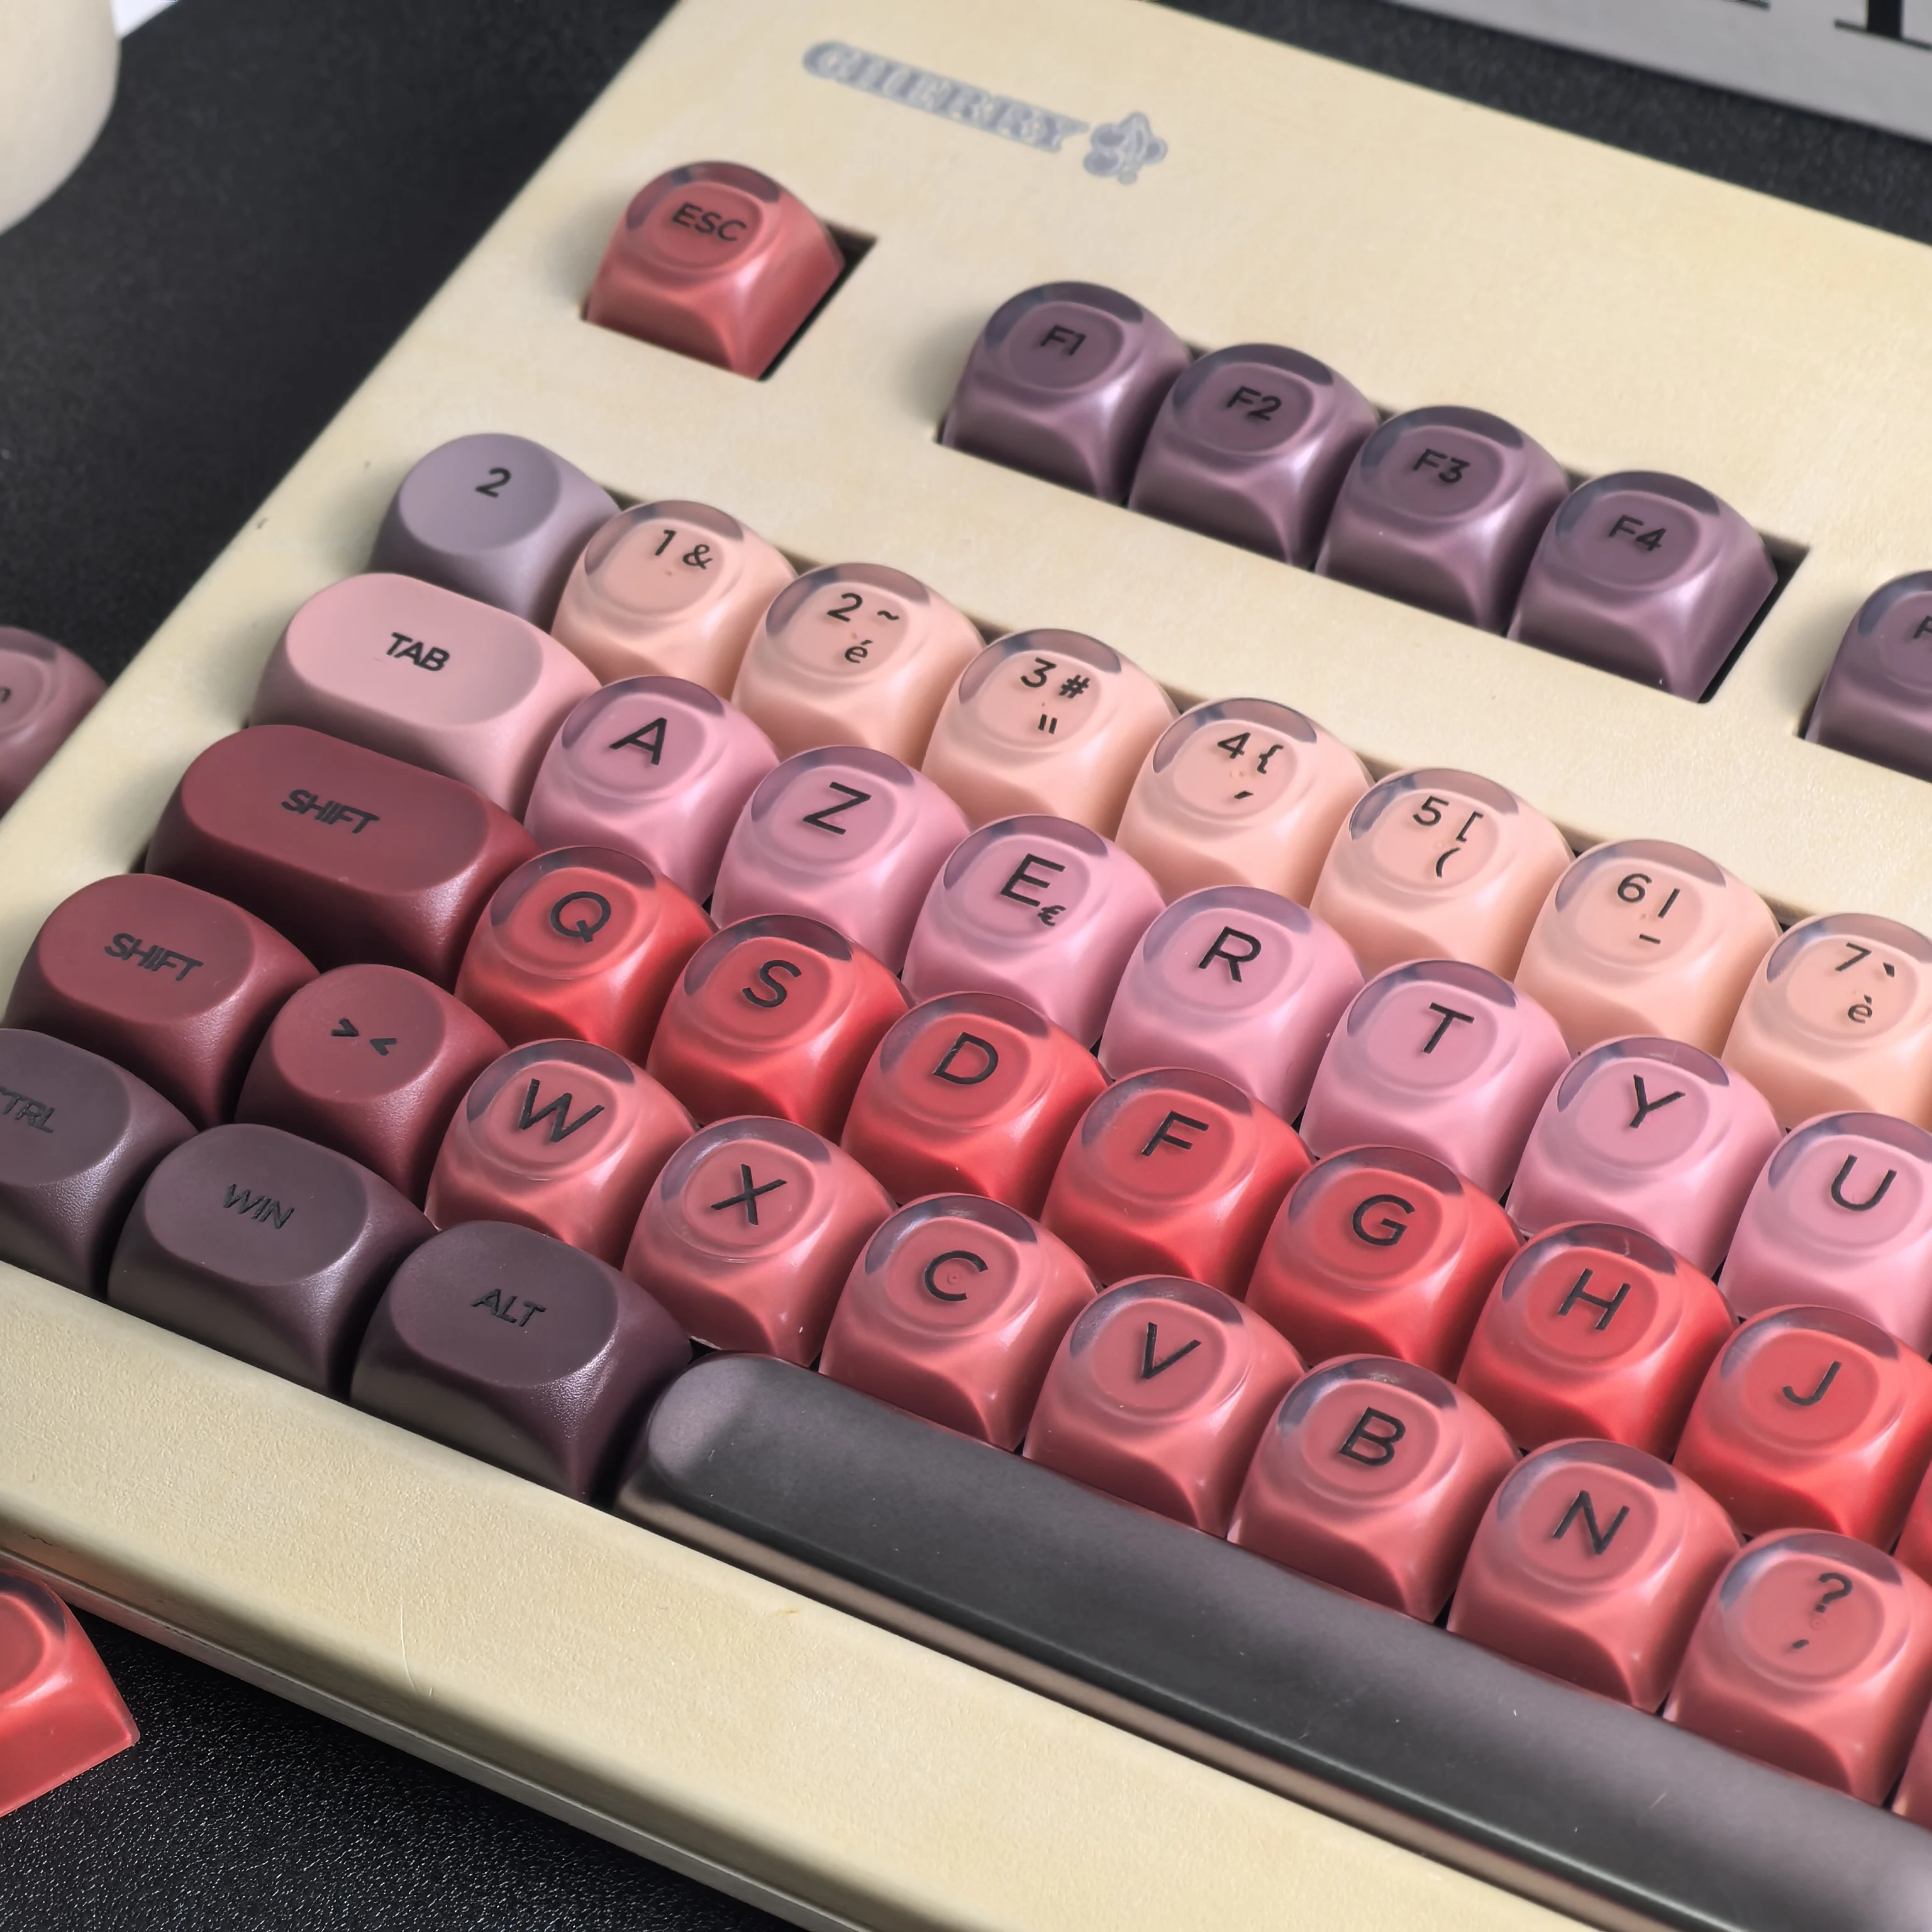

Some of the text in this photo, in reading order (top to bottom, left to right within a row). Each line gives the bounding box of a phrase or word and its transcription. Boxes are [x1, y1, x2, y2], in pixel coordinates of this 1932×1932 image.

[672, 202, 747, 242] ESC
[1040, 325, 1086, 356] F1
[1226, 386, 1282, 421] F2
[475, 467, 511, 498] 2
[1413, 448, 1471, 484] F3
[654, 529, 713, 570] 1 &
[1608, 514, 1667, 552] F4
[826, 592, 863, 623] 2
[385, 631, 451, 672] TAB
[844, 639, 874, 663] é
[1020, 657, 1057, 688] 3
[609, 717, 667, 765] A
[281, 789, 380, 835] SHIFT
[802, 781, 872, 835] Z
[1000, 853, 1065, 908] E
[550, 891, 612, 943] Q
[104, 933, 204, 981] SHIFT
[1197, 926, 1262, 983] R
[741, 959, 802, 1008] S
[1423, 1002, 1475, 1054] T
[1847, 994, 1873, 1024] è
[932, 1031, 999, 1085] D
[0, 1084, 55, 1133] TRL
[518, 1078, 605, 1143] W
[1629, 1074, 1685, 1129] Y
[1141, 1110, 1209, 1157] F
[710, 1163, 787, 1226] X
[1831, 1153, 1897, 1211] U
[223, 1184, 295, 1230] WIN
[1352, 1194, 1416, 1246] G
[924, 1250, 988, 1302] C
[1557, 1267, 1631, 1331] H
[471, 1288, 547, 1328] ALT
[1142, 1321, 1202, 1379] V
[1782, 1360, 1841, 1406] J
[1338, 1406, 1406, 1467] B
[1552, 1489, 1630, 1555] N
[1814, 1572, 1853, 1613] ?
